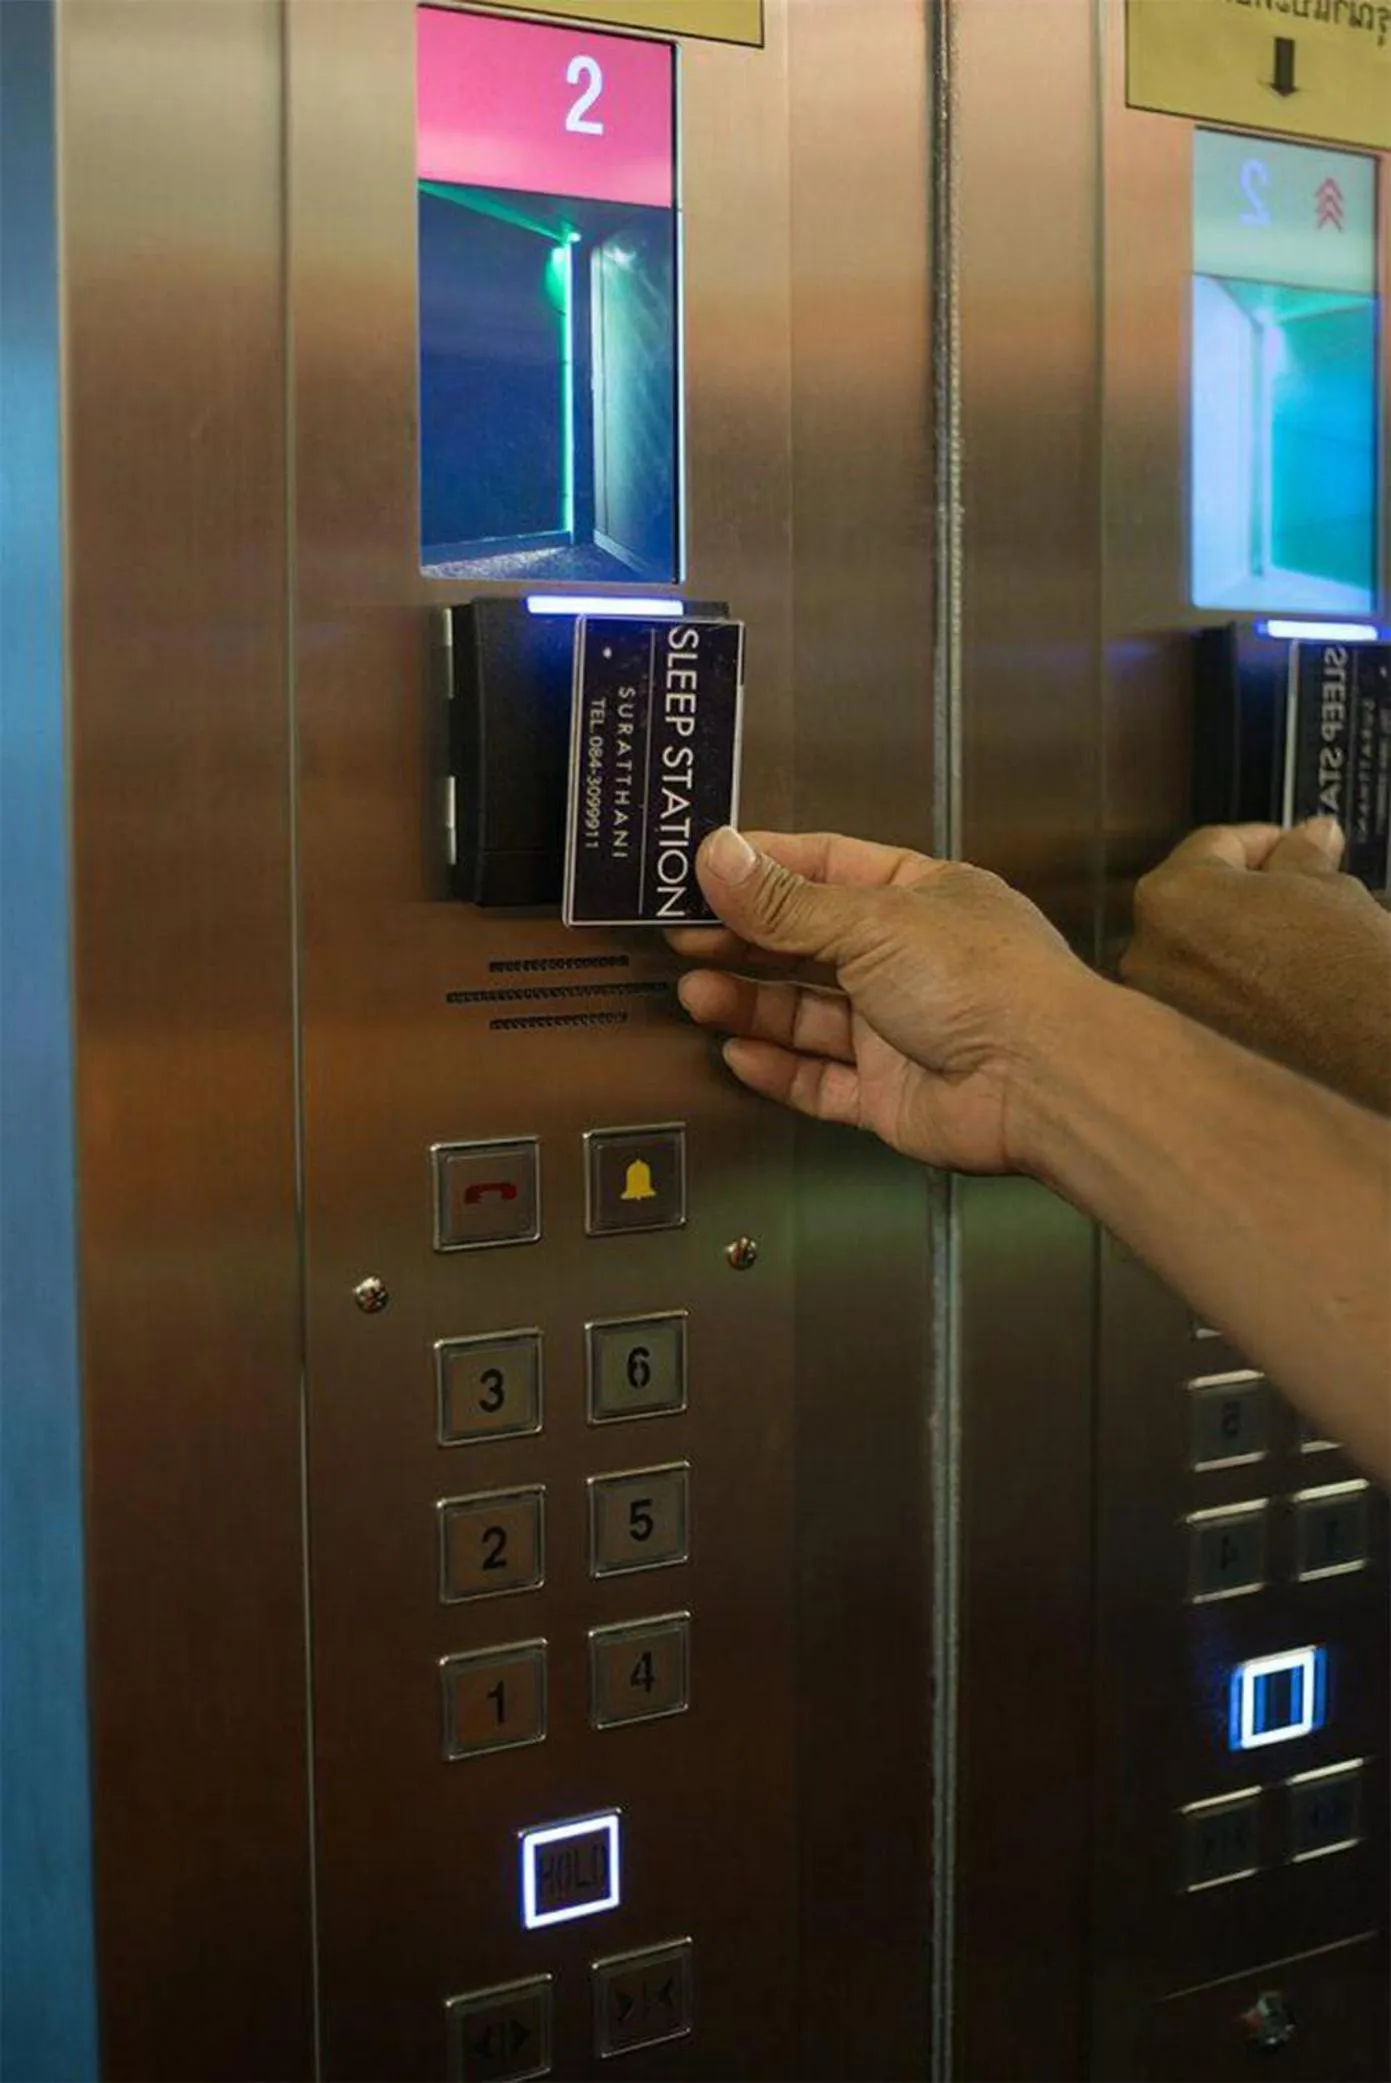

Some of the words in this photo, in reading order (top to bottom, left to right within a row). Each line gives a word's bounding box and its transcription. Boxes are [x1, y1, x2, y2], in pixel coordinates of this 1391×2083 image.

[565, 55, 604, 135] 2
[665, 627, 699, 737] SLEEP
[612, 686, 636, 858] SURATTHANI
[656, 747, 693, 918] STATION
[627, 1346, 650, 1389] 6
[479, 1368, 505, 1413] 3
[629, 1500, 654, 1541] 5
[482, 1526, 507, 1570] 2
[629, 1651, 655, 1694] 4
[487, 1680, 505, 1725] 1
[539, 1844, 607, 1897] HOLD
